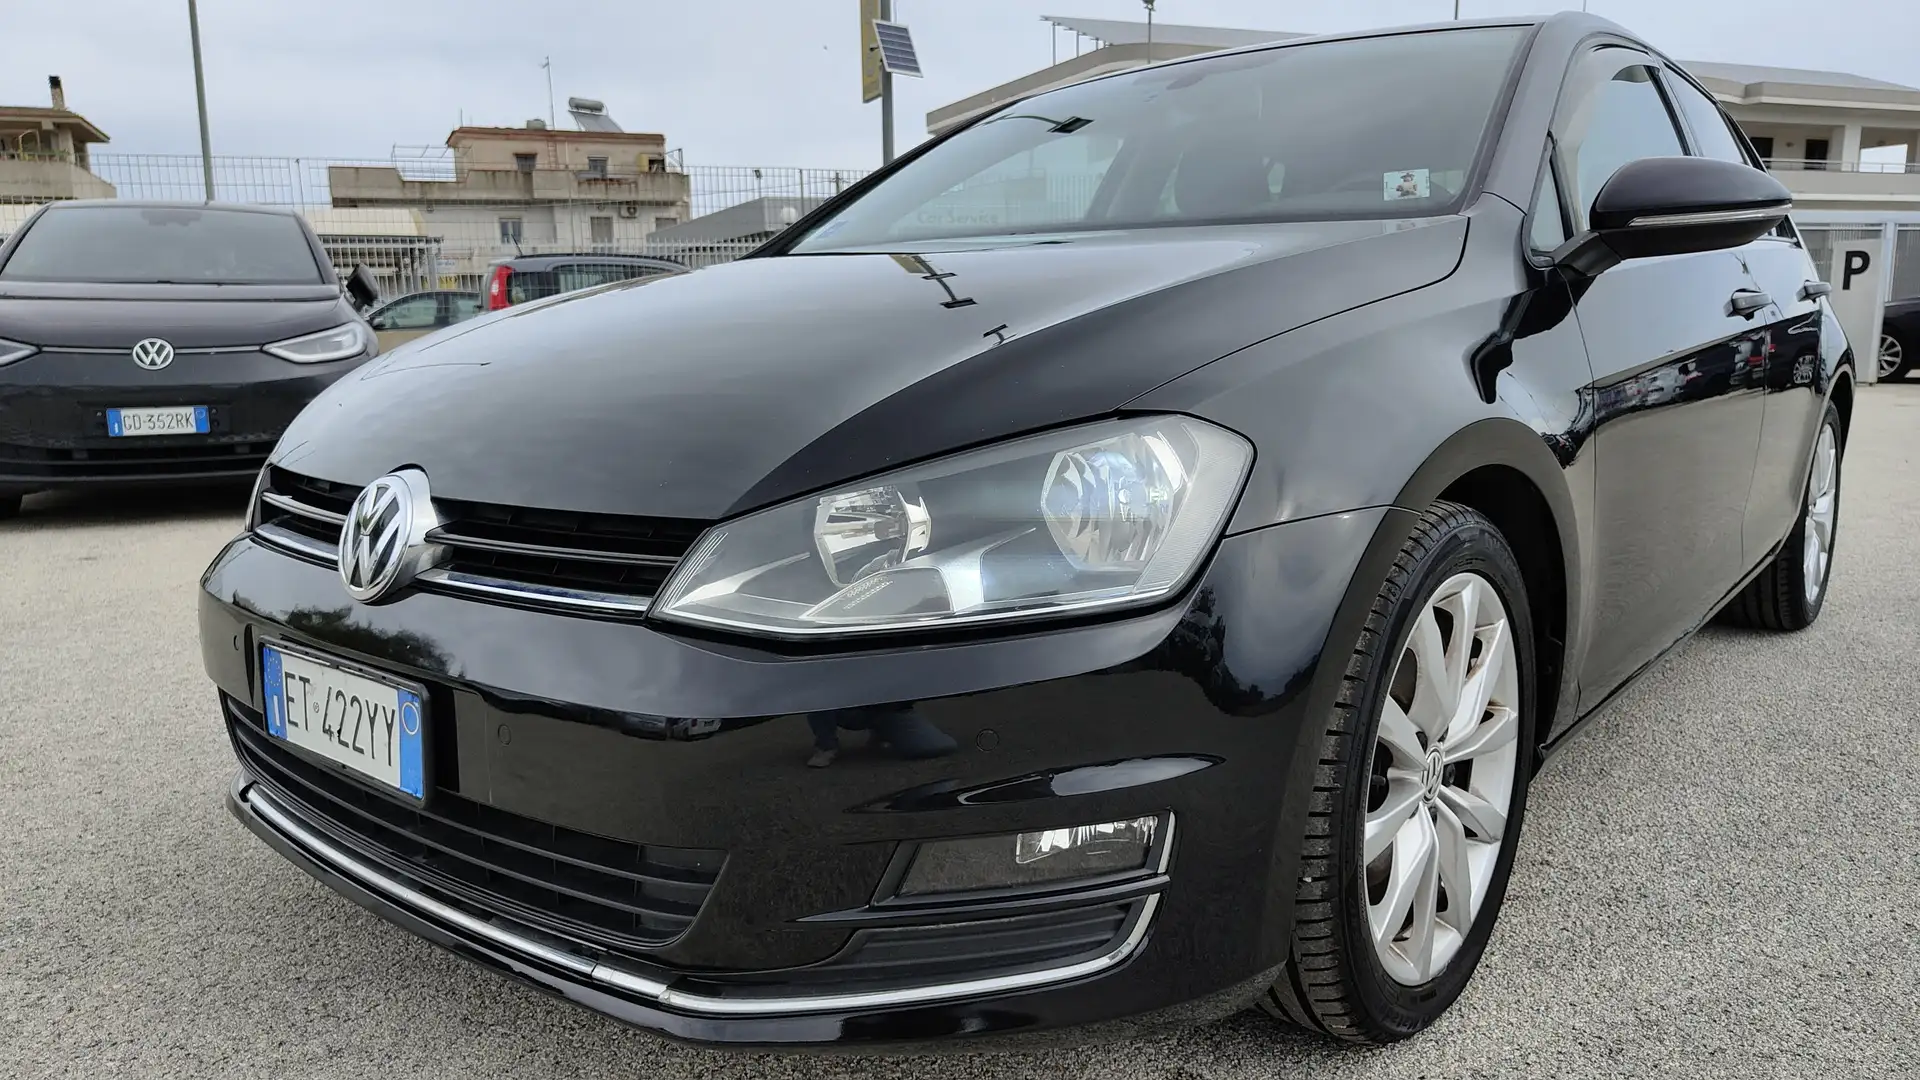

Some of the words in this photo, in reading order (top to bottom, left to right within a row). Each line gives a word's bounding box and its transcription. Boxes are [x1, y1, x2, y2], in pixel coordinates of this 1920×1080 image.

[1842, 250, 1871, 291] P
[284, 671, 311, 732] ET
[322, 685, 396, 767] 422YY
